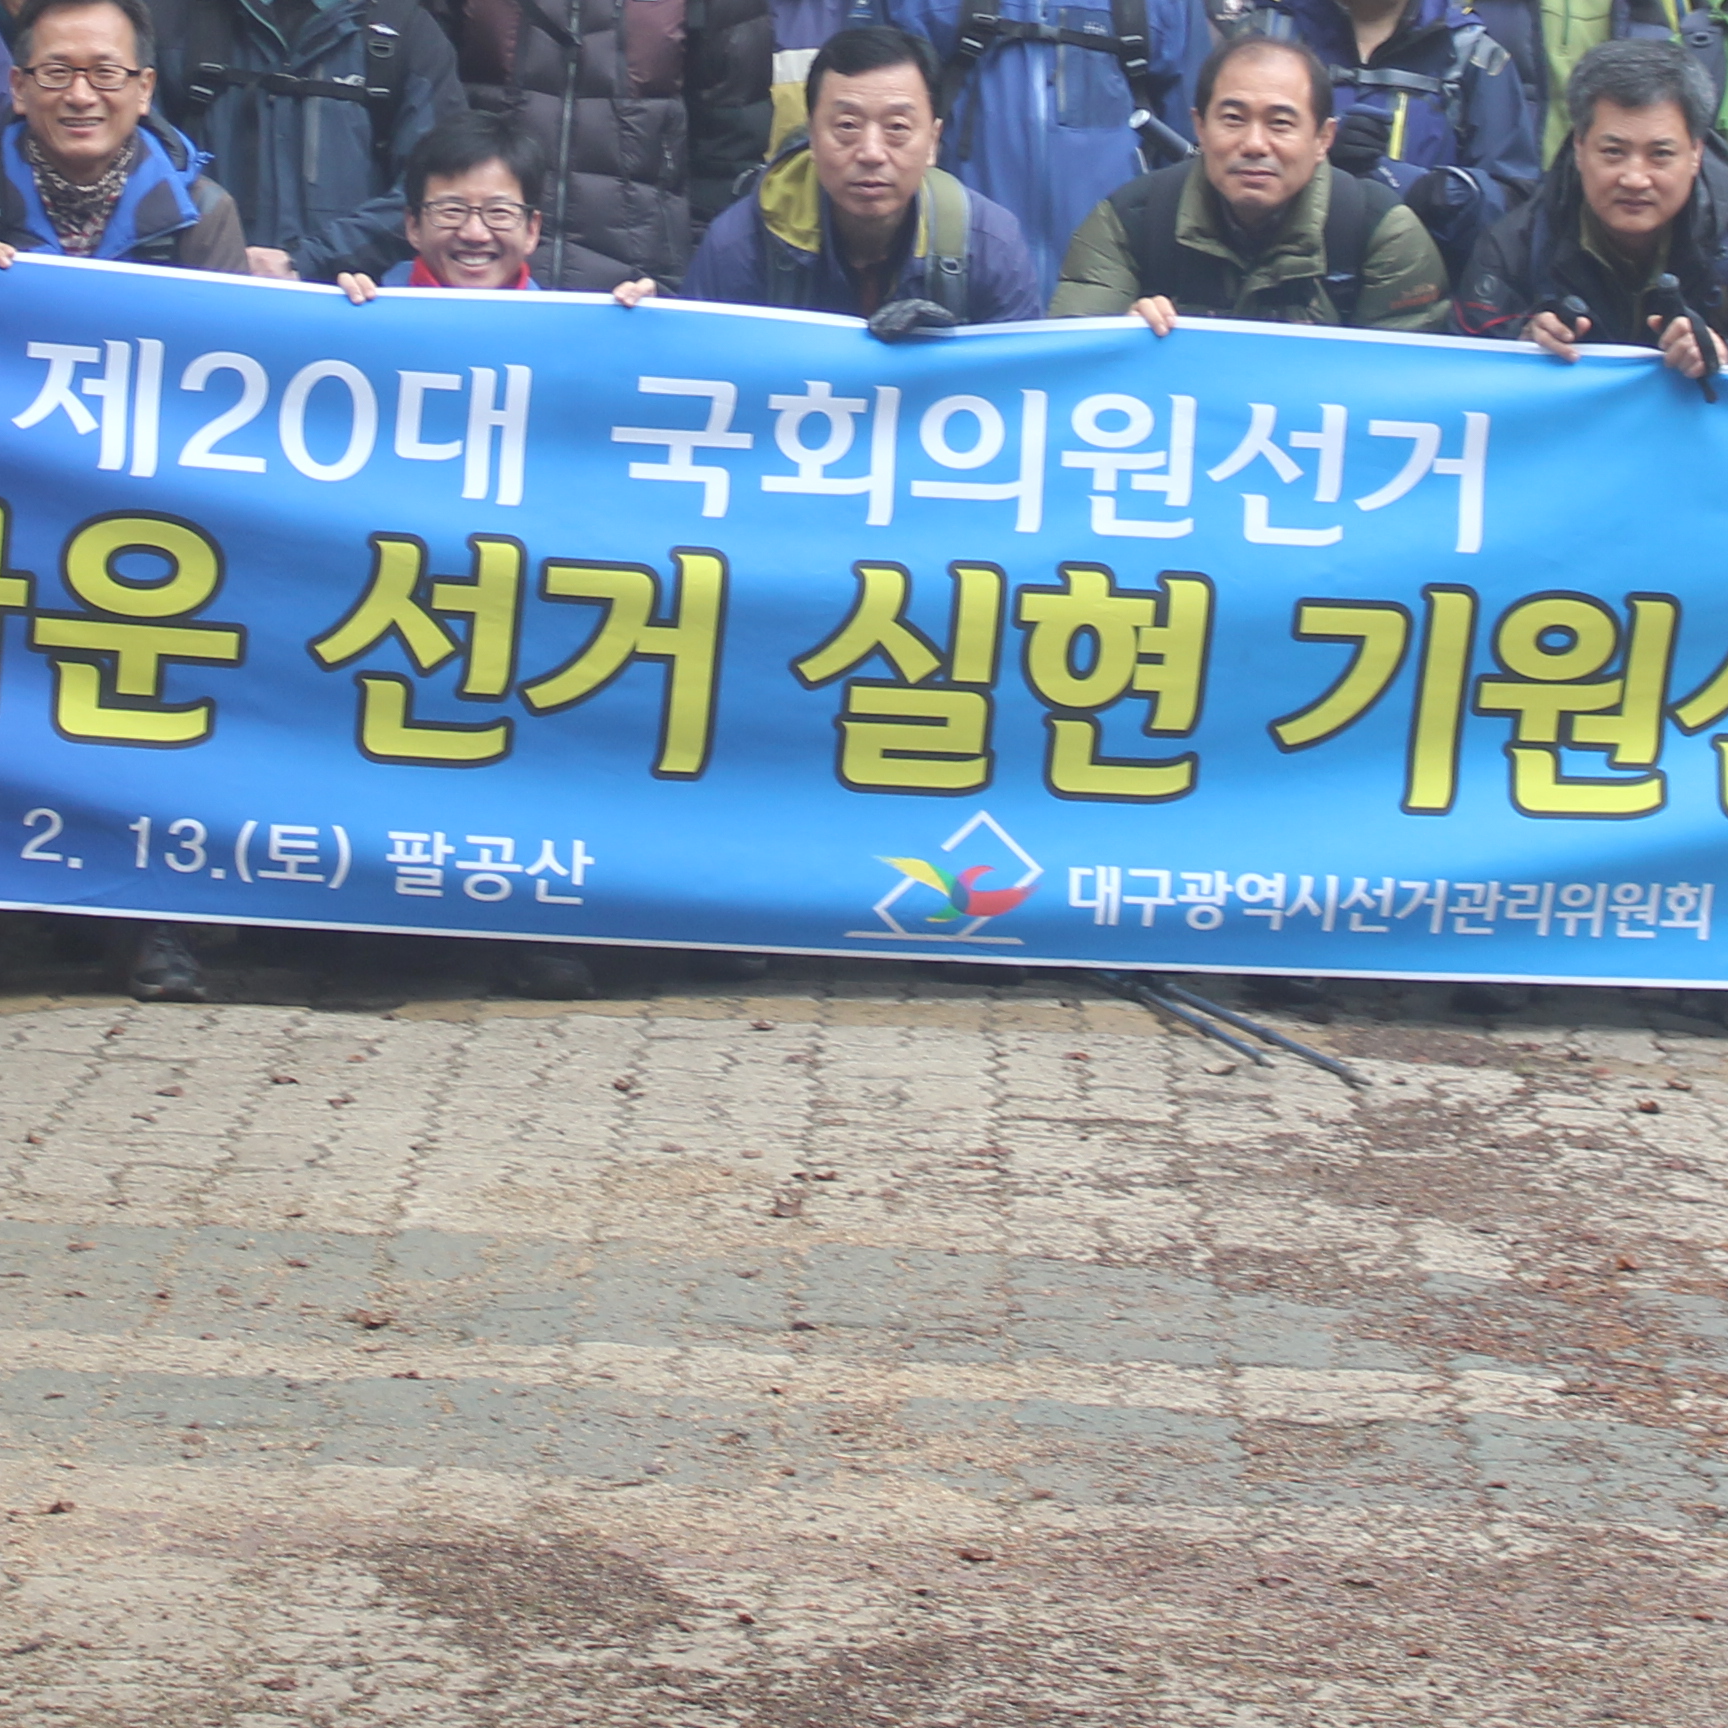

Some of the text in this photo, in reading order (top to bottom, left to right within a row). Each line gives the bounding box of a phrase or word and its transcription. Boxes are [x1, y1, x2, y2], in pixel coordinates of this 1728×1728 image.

[15, 339, 1489, 552] 제20대 국회의원선거
[310, 533, 729, 779] 선거
[796, 561, 1213, 801] 실현
[22, 810, 83, 870] 2.
[128, 817, 349, 890] 13.(토)
[385, 830, 594, 906] 팔공산
[1070, 865, 1712, 940] 대구광역시선거관리위원회
